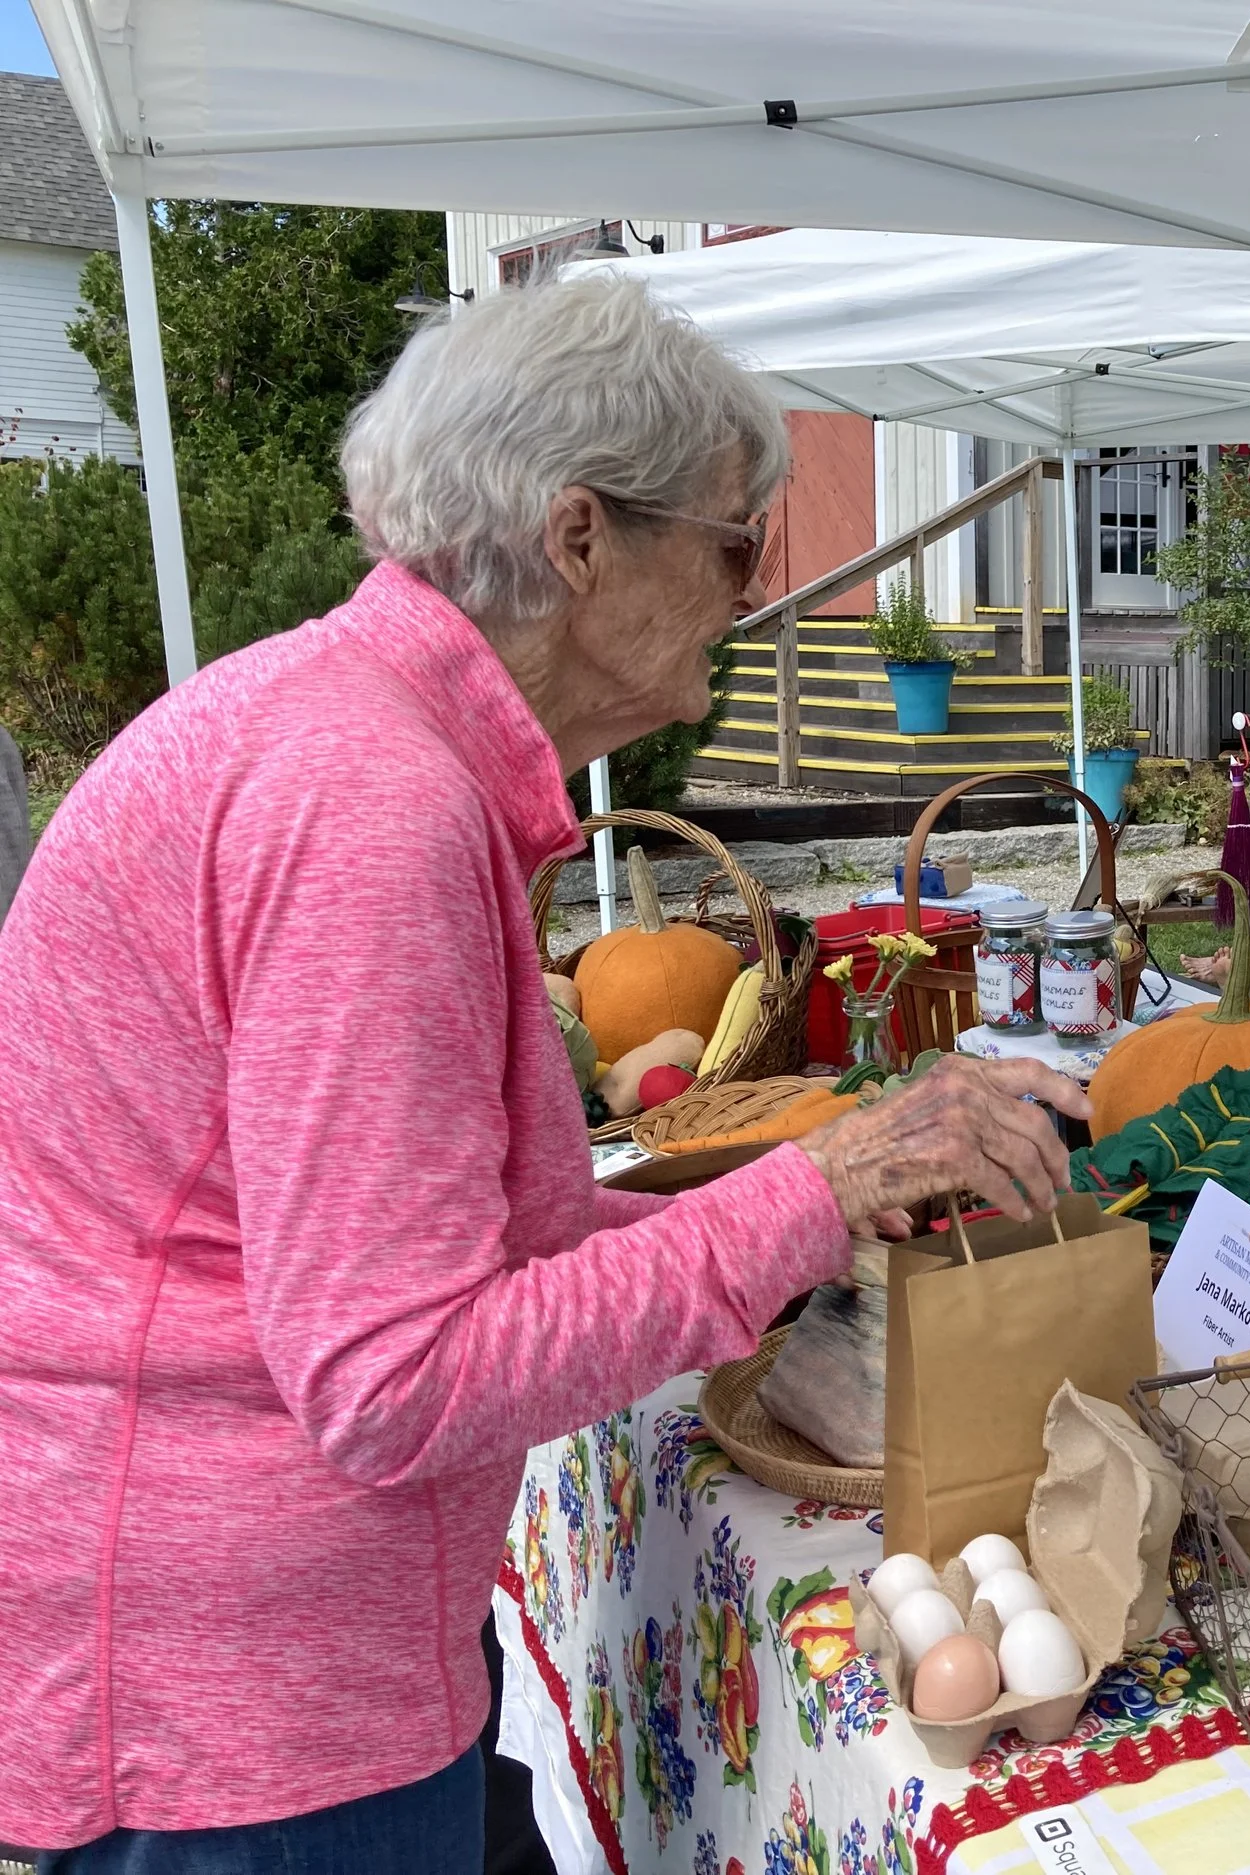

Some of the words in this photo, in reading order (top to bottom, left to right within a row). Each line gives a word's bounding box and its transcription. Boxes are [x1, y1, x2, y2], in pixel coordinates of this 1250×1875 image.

[1219, 1234, 1247, 1260] ARTISAN
[1214, 1249, 1221, 1260] &
[1219, 1252, 1250, 1281] COMMUNITY
[1195, 1271, 1221, 1302] Jana
[1202, 1314, 1219, 1334] Fiber
[1217, 1327, 1236, 1348] Artist
